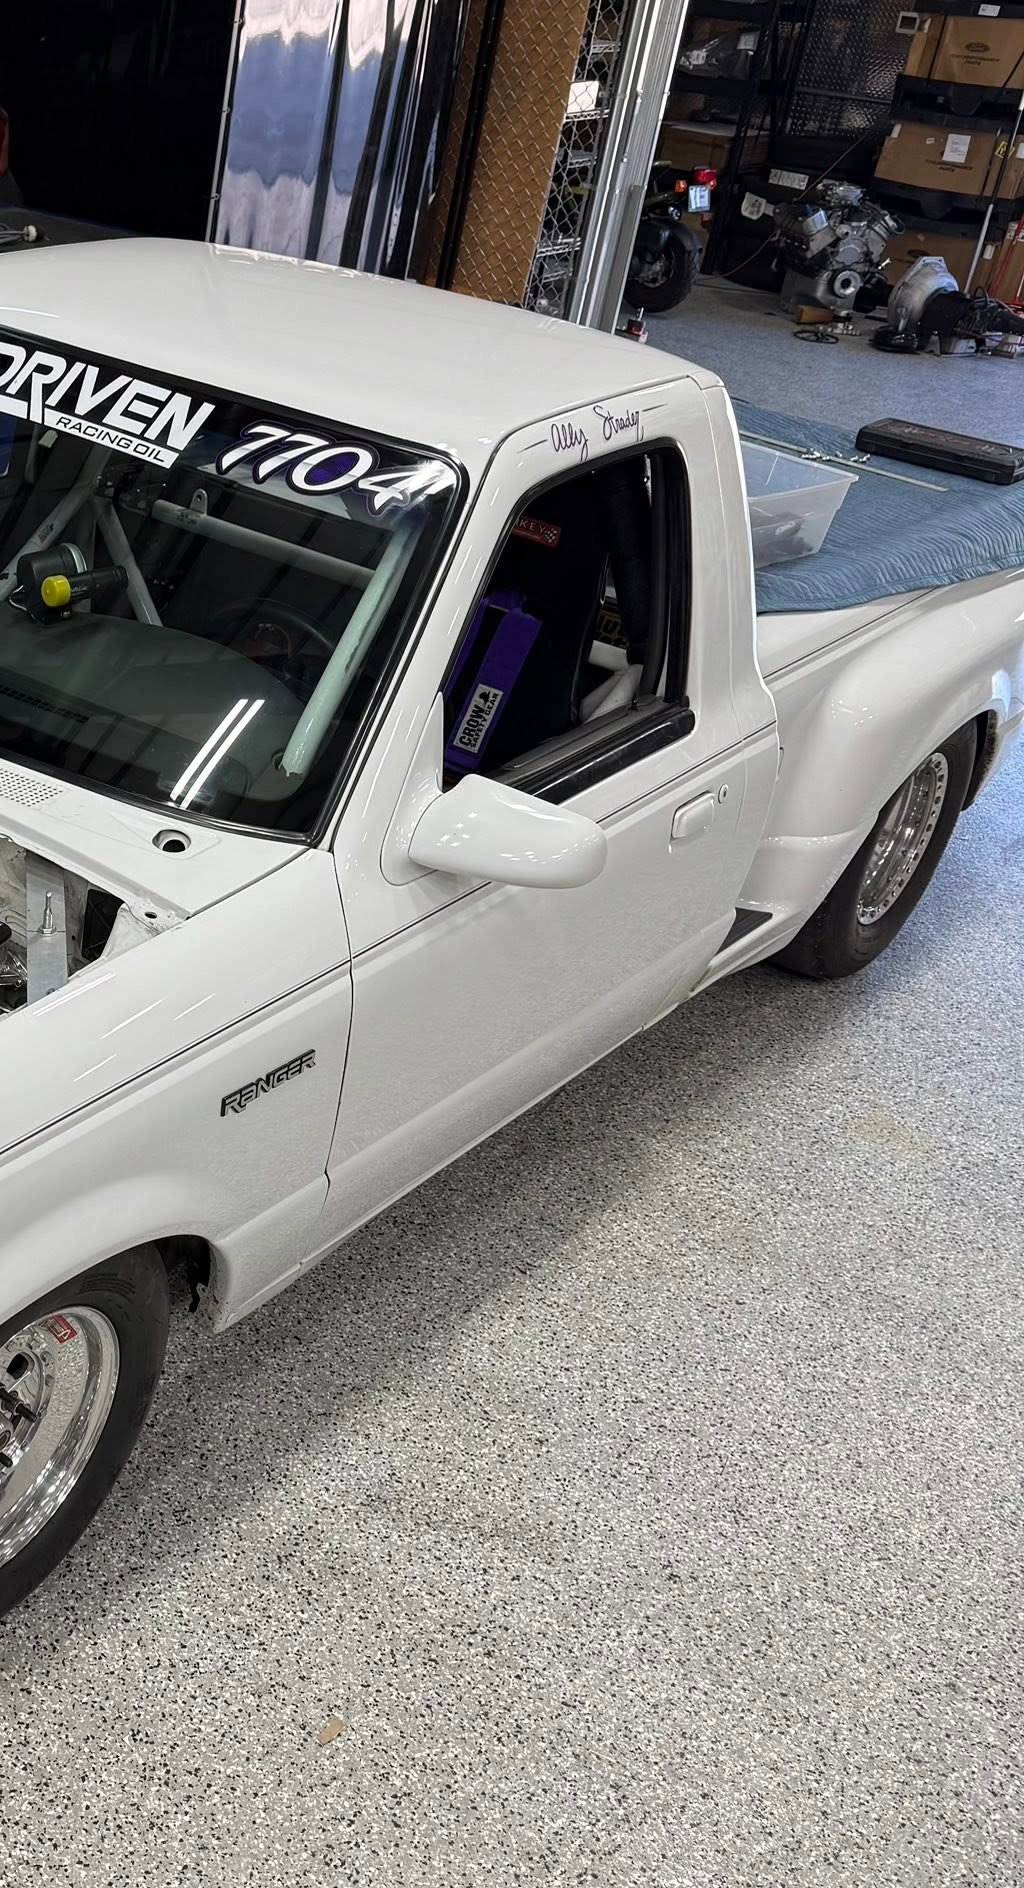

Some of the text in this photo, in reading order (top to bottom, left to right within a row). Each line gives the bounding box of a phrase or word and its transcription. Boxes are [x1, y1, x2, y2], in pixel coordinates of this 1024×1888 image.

[55, 416, 166, 464] RACING OIL
[214, 422, 431, 516] 7704
[459, 705, 485, 746] CROW
[470, 692, 500, 749] SAFETY GEAR
[220, 1048, 316, 1117] RANGER
